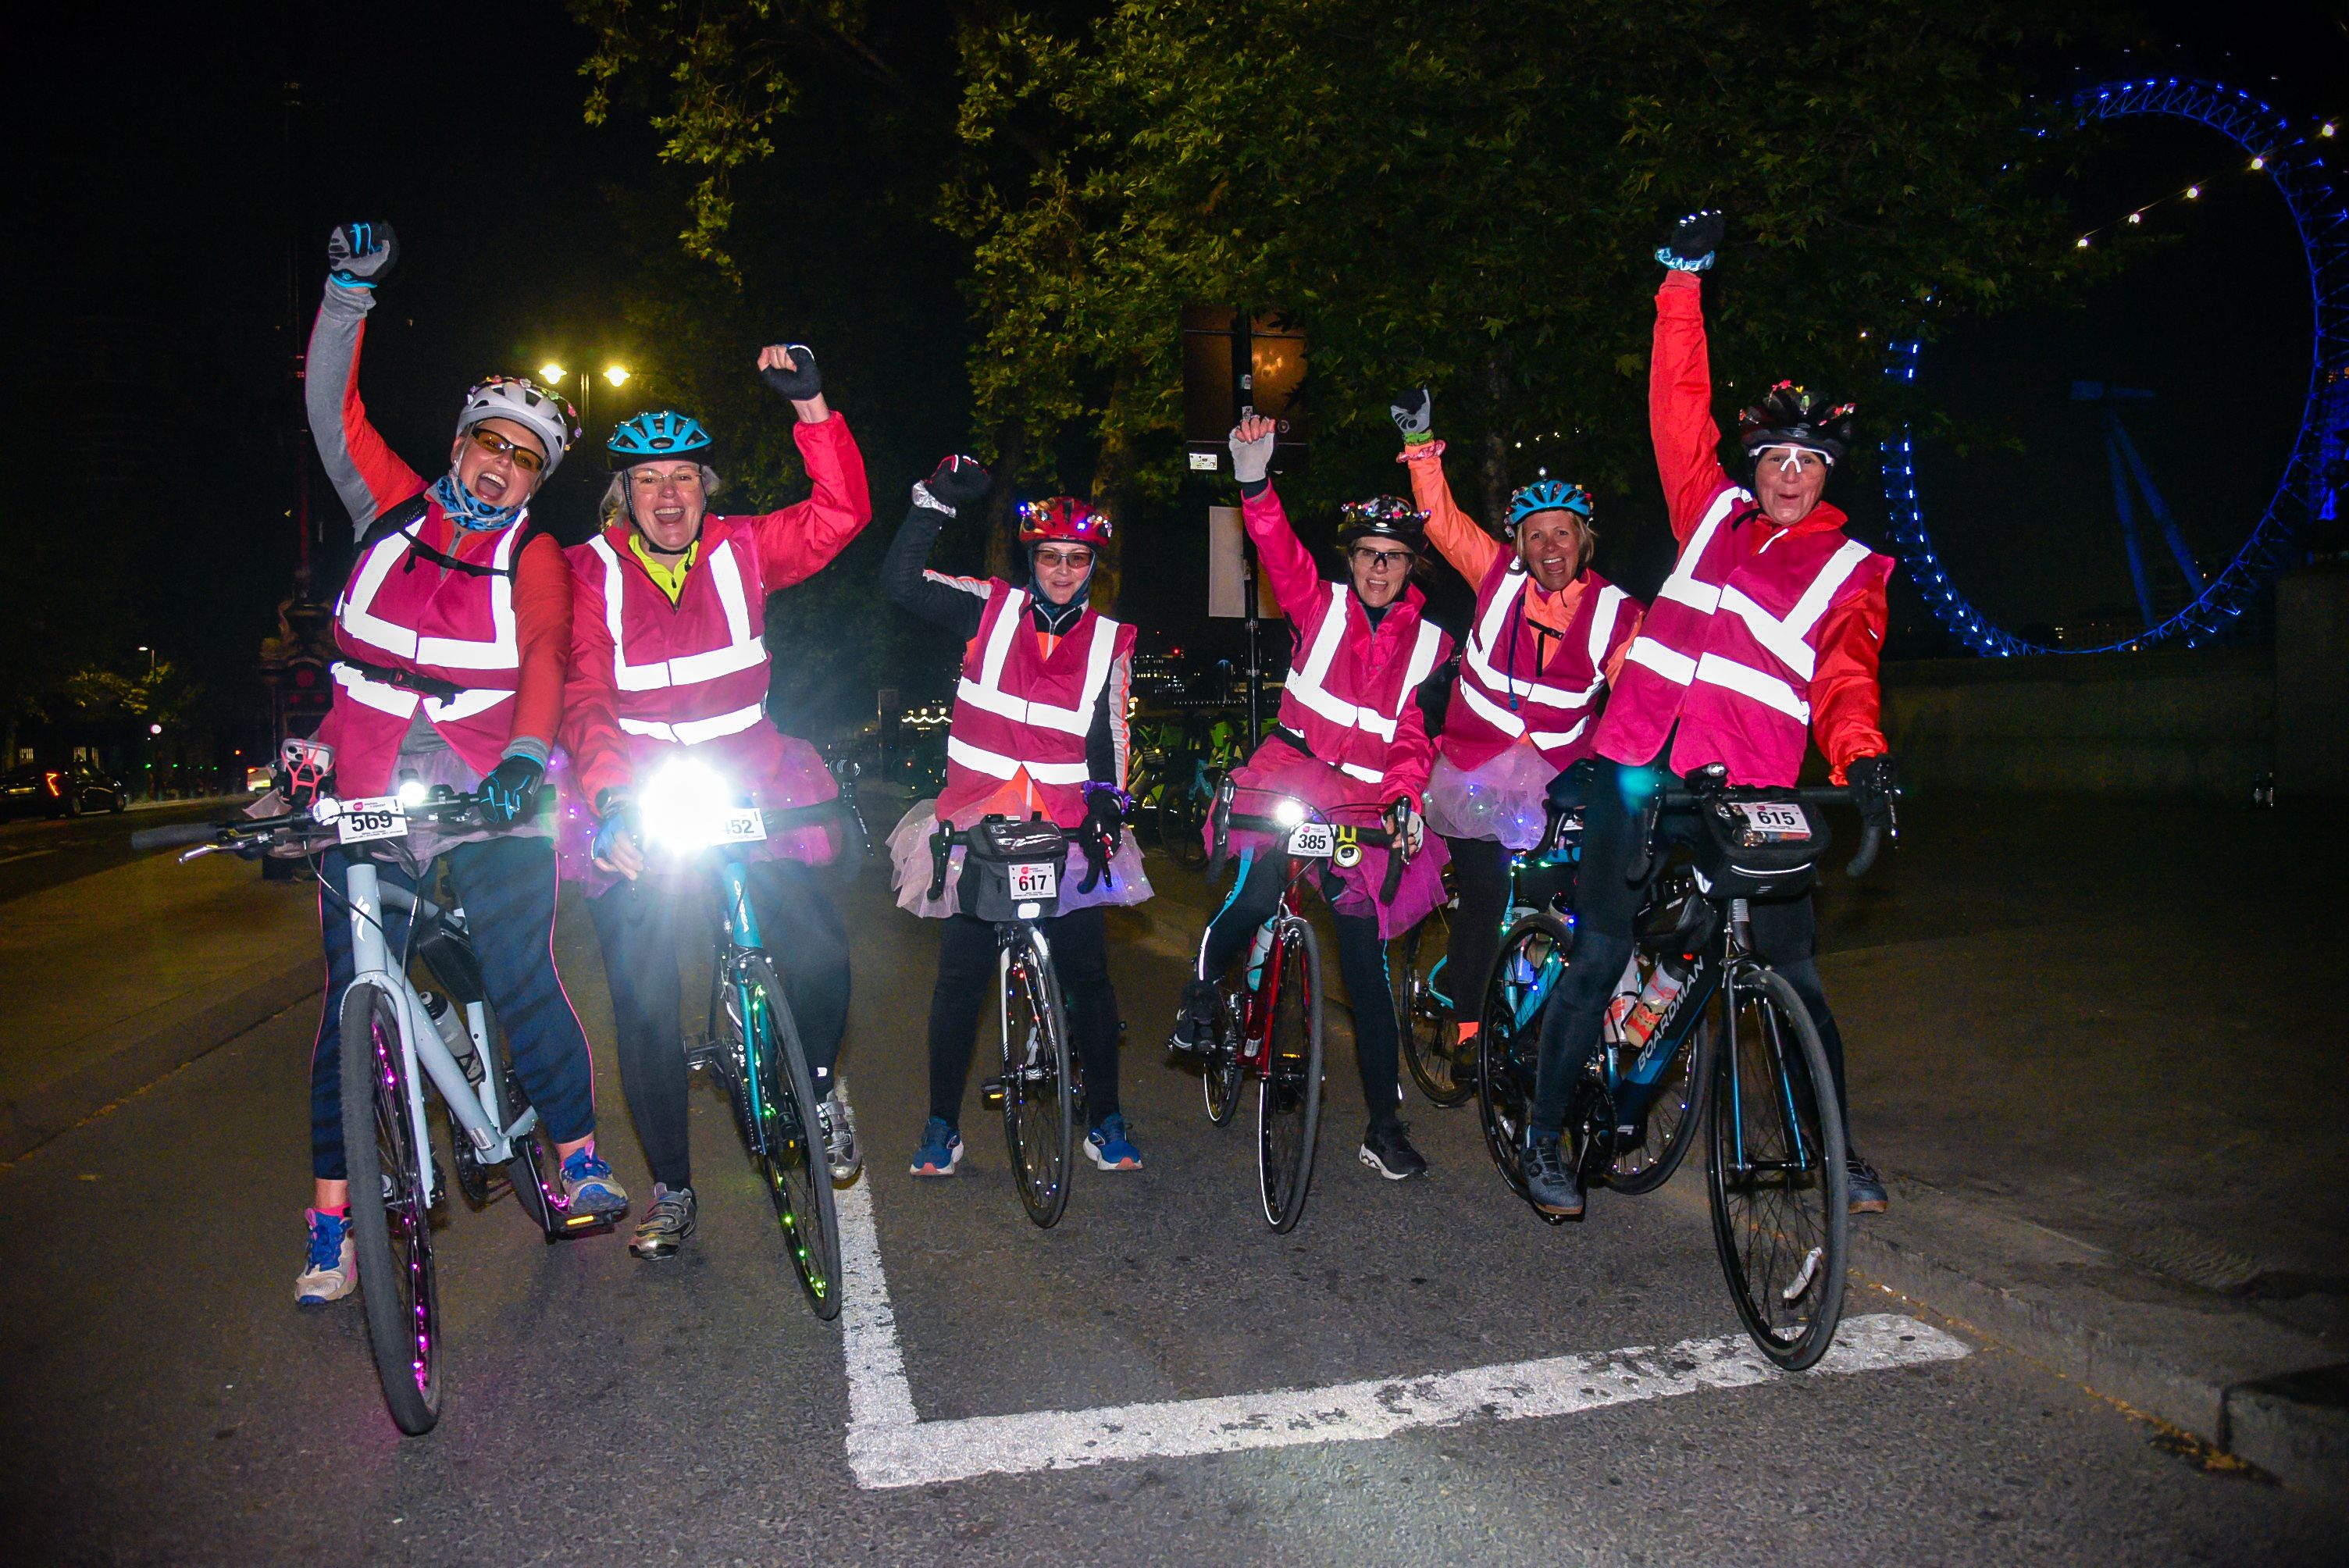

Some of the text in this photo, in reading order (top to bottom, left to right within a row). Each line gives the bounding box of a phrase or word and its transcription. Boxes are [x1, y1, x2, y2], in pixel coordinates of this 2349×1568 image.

[351, 810, 392, 832] 569
[1756, 811, 1795, 825] 615
[1297, 833, 1327, 850] 385
[1018, 875, 1047, 892] 617
[1638, 955, 1704, 1073] BOARDMAN
